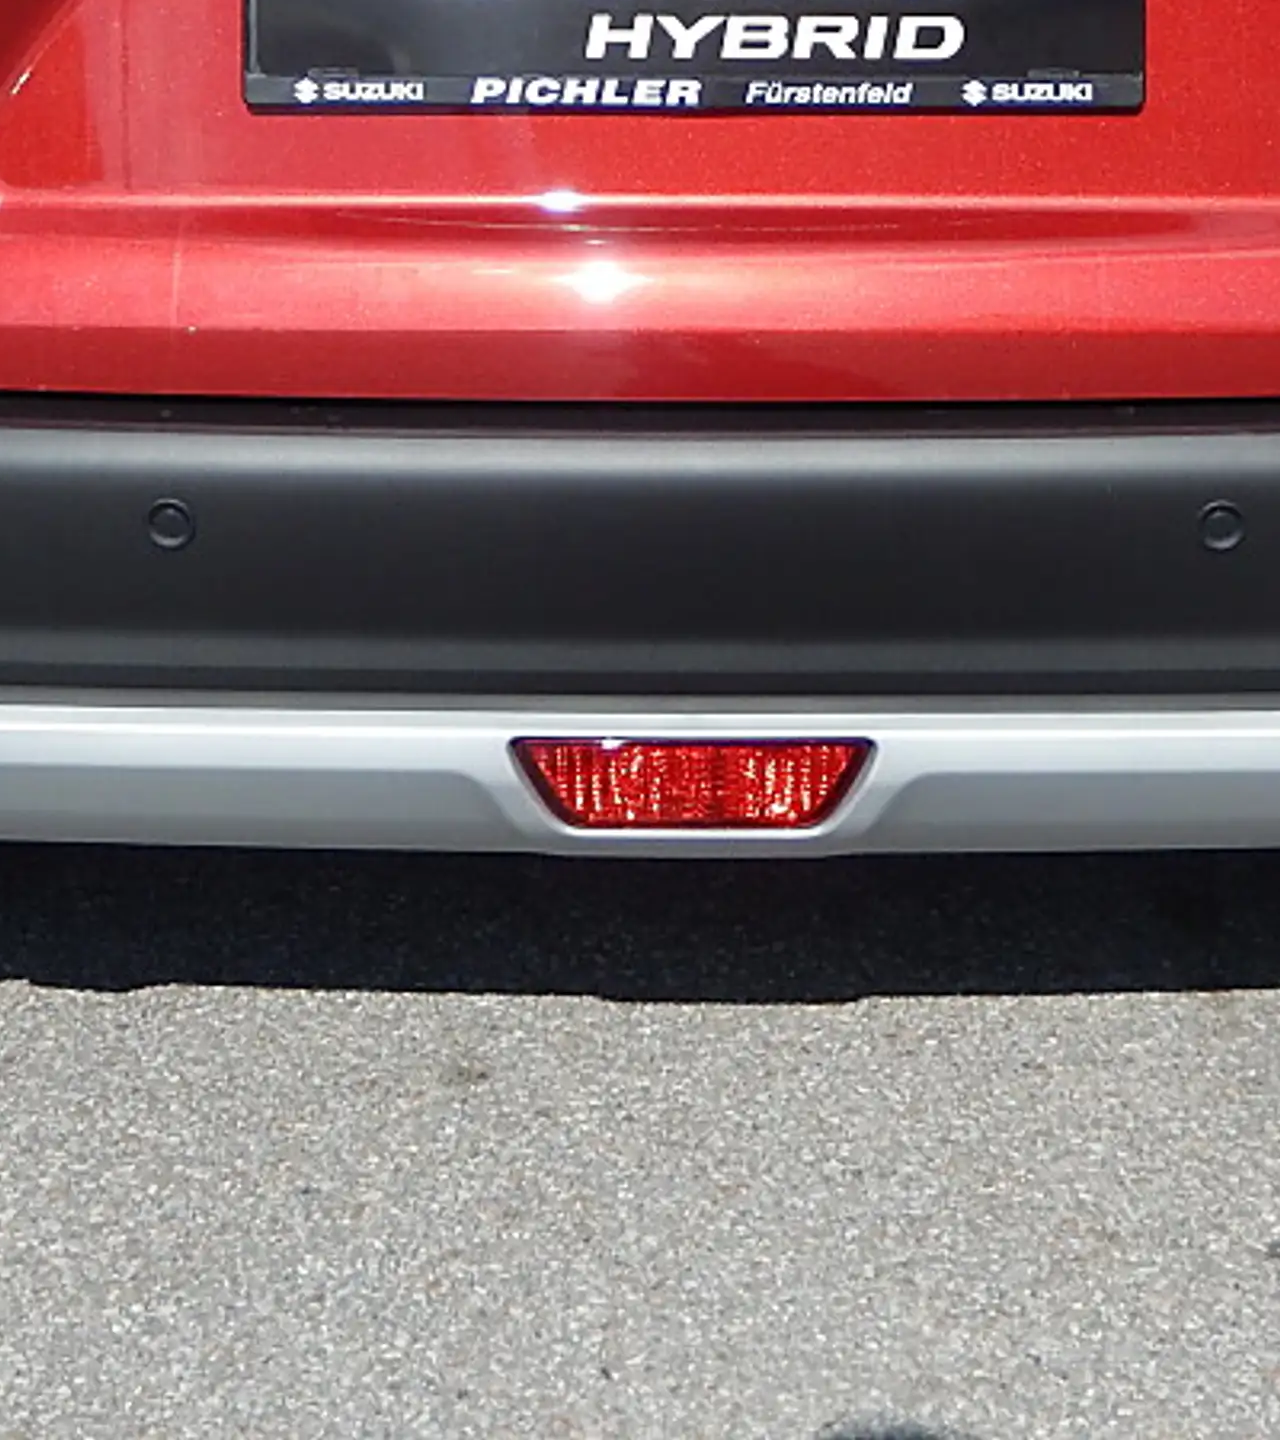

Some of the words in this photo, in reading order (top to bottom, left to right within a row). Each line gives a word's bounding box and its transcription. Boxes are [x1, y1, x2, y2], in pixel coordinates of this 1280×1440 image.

[584, 13, 966, 60] HYBRID
[323, 82, 424, 101] SUZUKI
[470, 76, 703, 105] PICHLER
[745, 80, 914, 104] Fürstenfeld
[991, 82, 1094, 101] SUZUKI
